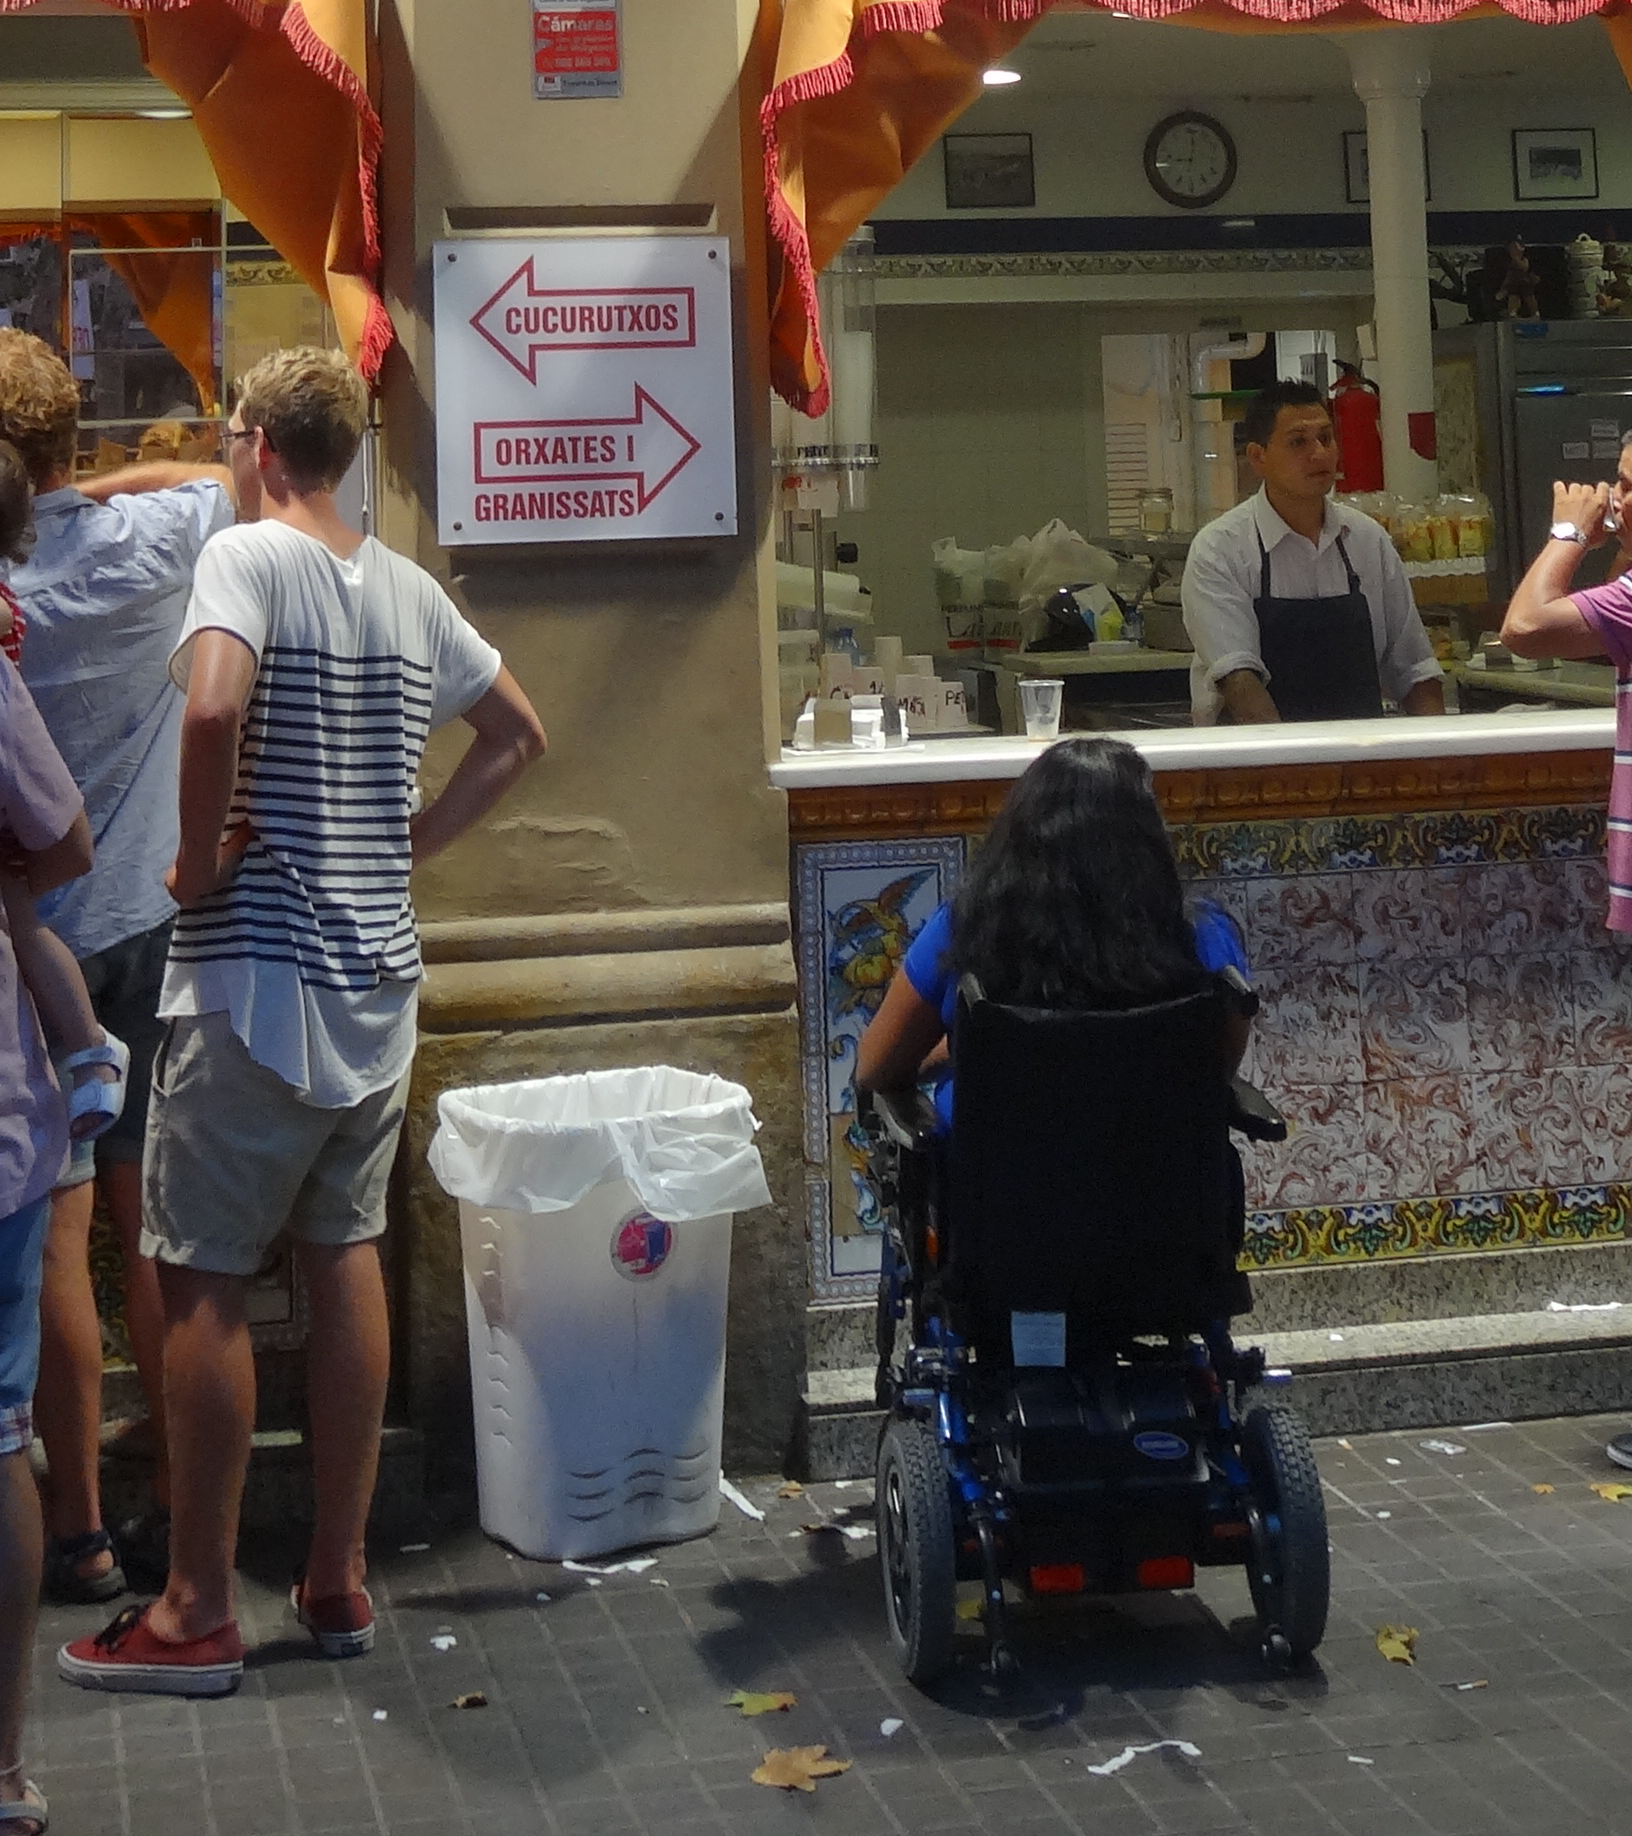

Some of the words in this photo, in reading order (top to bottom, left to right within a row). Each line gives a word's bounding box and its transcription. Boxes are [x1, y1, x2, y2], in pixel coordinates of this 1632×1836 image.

[505, 303, 680, 335] CUCURUTXOS
[495, 435, 616, 467] ORXATES
[626, 435, 635, 462] I
[475, 489, 636, 523] GRANISSATS
